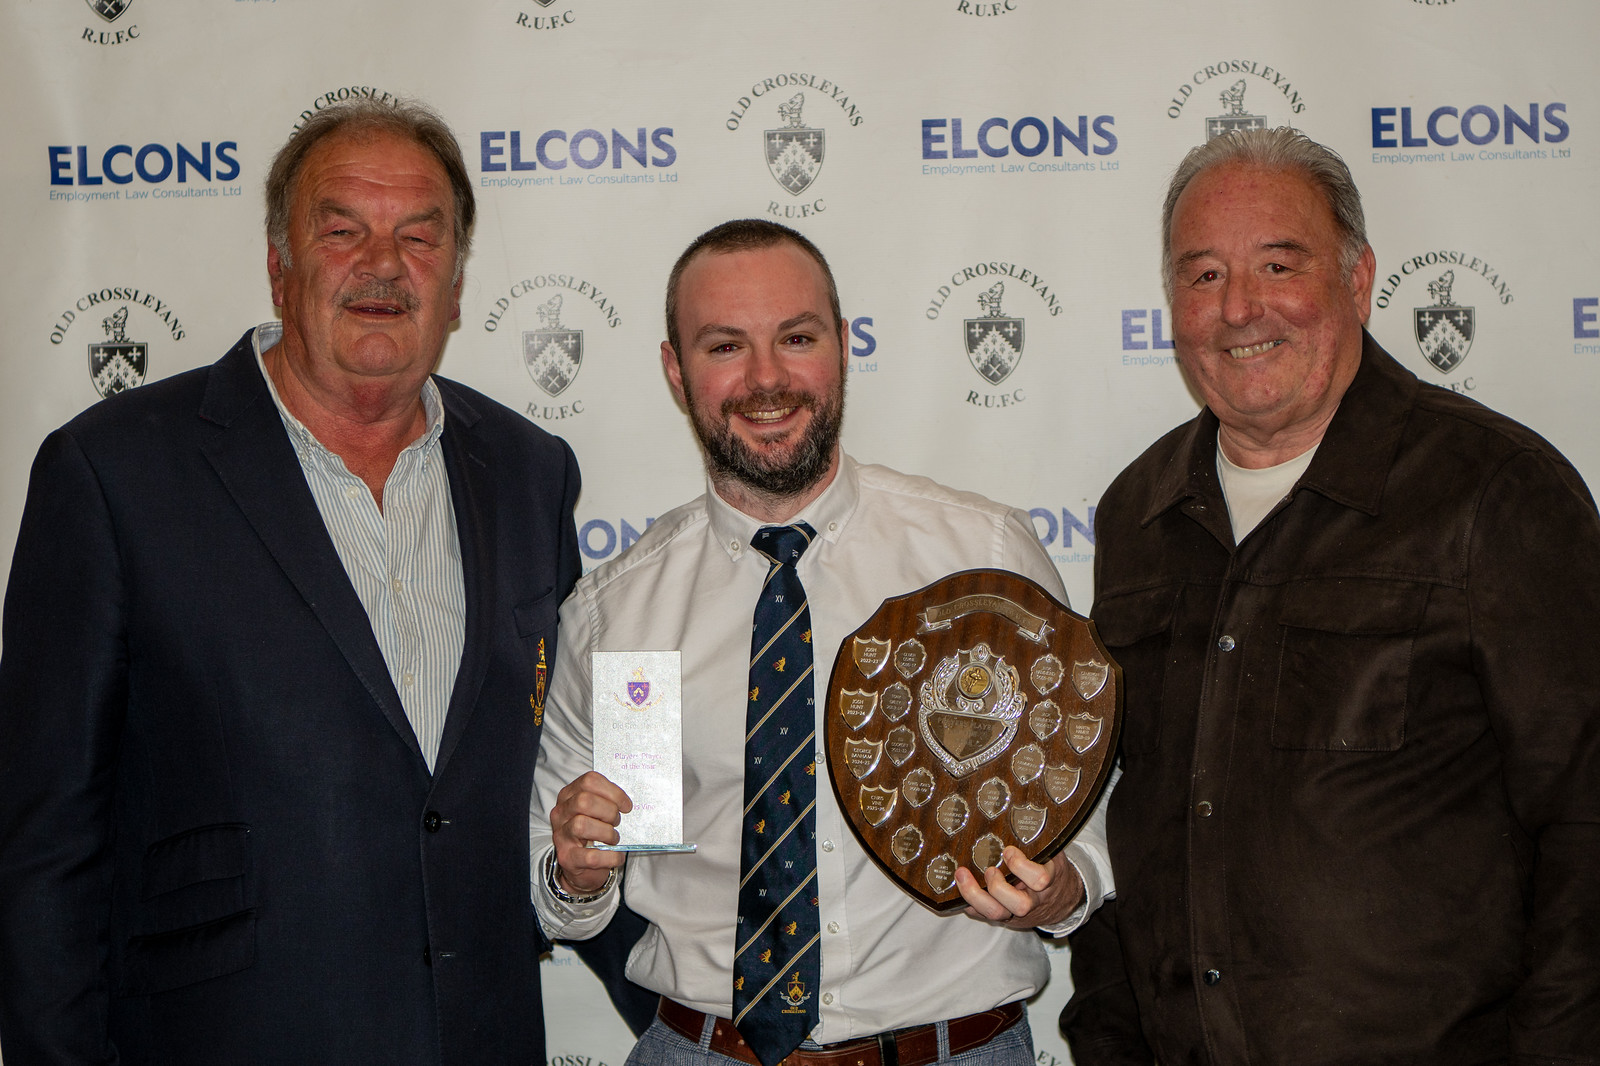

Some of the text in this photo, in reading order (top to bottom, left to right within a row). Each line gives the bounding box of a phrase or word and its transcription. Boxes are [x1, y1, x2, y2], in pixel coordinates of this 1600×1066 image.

[516, 10, 576, 30] R.U.F.C
[81, 25, 141, 45] R.U.F.C
[314, 86, 399, 110] CROSSLE
[1167, 59, 1306, 119] OLD CROSSLEYANS
[725, 72, 863, 131] OLD CROSSLEYANS
[1371, 102, 1570, 148] ELCONS
[921, 115, 1118, 160] ELCONS
[480, 127, 677, 172] ELCONS
[1372, 147, 1571, 165] Employment Law Consultants Ltd
[48, 141, 240, 185] ELCONS
[922, 160, 1119, 176] Employment Law Consultants Ltd
[481, 172, 678, 188] Employment Law Consultants Ltd
[49, 185, 241, 202] Employment Law Consultants Ltd
[766, 198, 826, 219] R.U.F.C
[1376, 250, 1514, 309] OLD CROSSLEYANS
[926, 262, 1063, 321] OLD CROSSLEYANS
[484, 273, 622, 333] OLD CROSSLEYANS
[50, 287, 186, 345] OLD CROSSLEYANS
[858, 361, 878, 372] Ltd
[966, 388, 1025, 408] R.U.F.C
[526, 400, 584, 420] R.U.F.C
[775, 594, 784, 603] XV
[780, 727, 789, 735] XV
[785, 861, 793, 869] XV
[759, 889, 767, 897] XV
